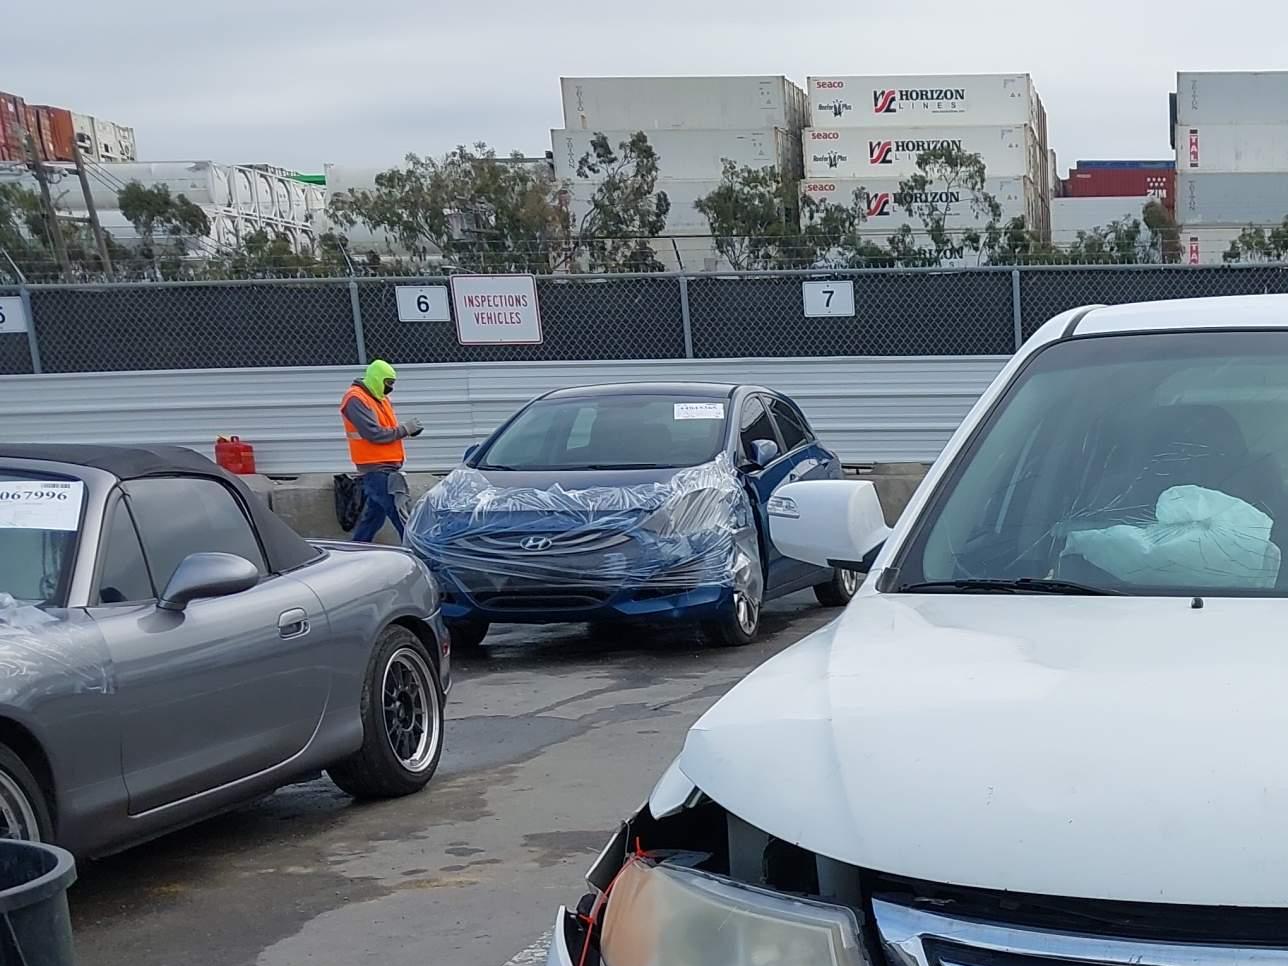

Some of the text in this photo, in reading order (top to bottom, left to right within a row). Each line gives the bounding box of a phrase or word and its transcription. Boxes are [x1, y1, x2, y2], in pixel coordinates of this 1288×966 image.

[816, 81, 844, 89] seaco
[898, 89, 965, 101] HORIZON
[899, 102, 956, 110] LINES
[811, 132, 839, 140] seaco
[895, 140, 962, 152] HORIZON
[807, 184, 836, 192] seaco
[416, 295, 430, 313] 6
[463, 294, 528, 308] INSPECTIONS
[822, 290, 835, 308] 7
[473, 311, 522, 325] VEHICLES
